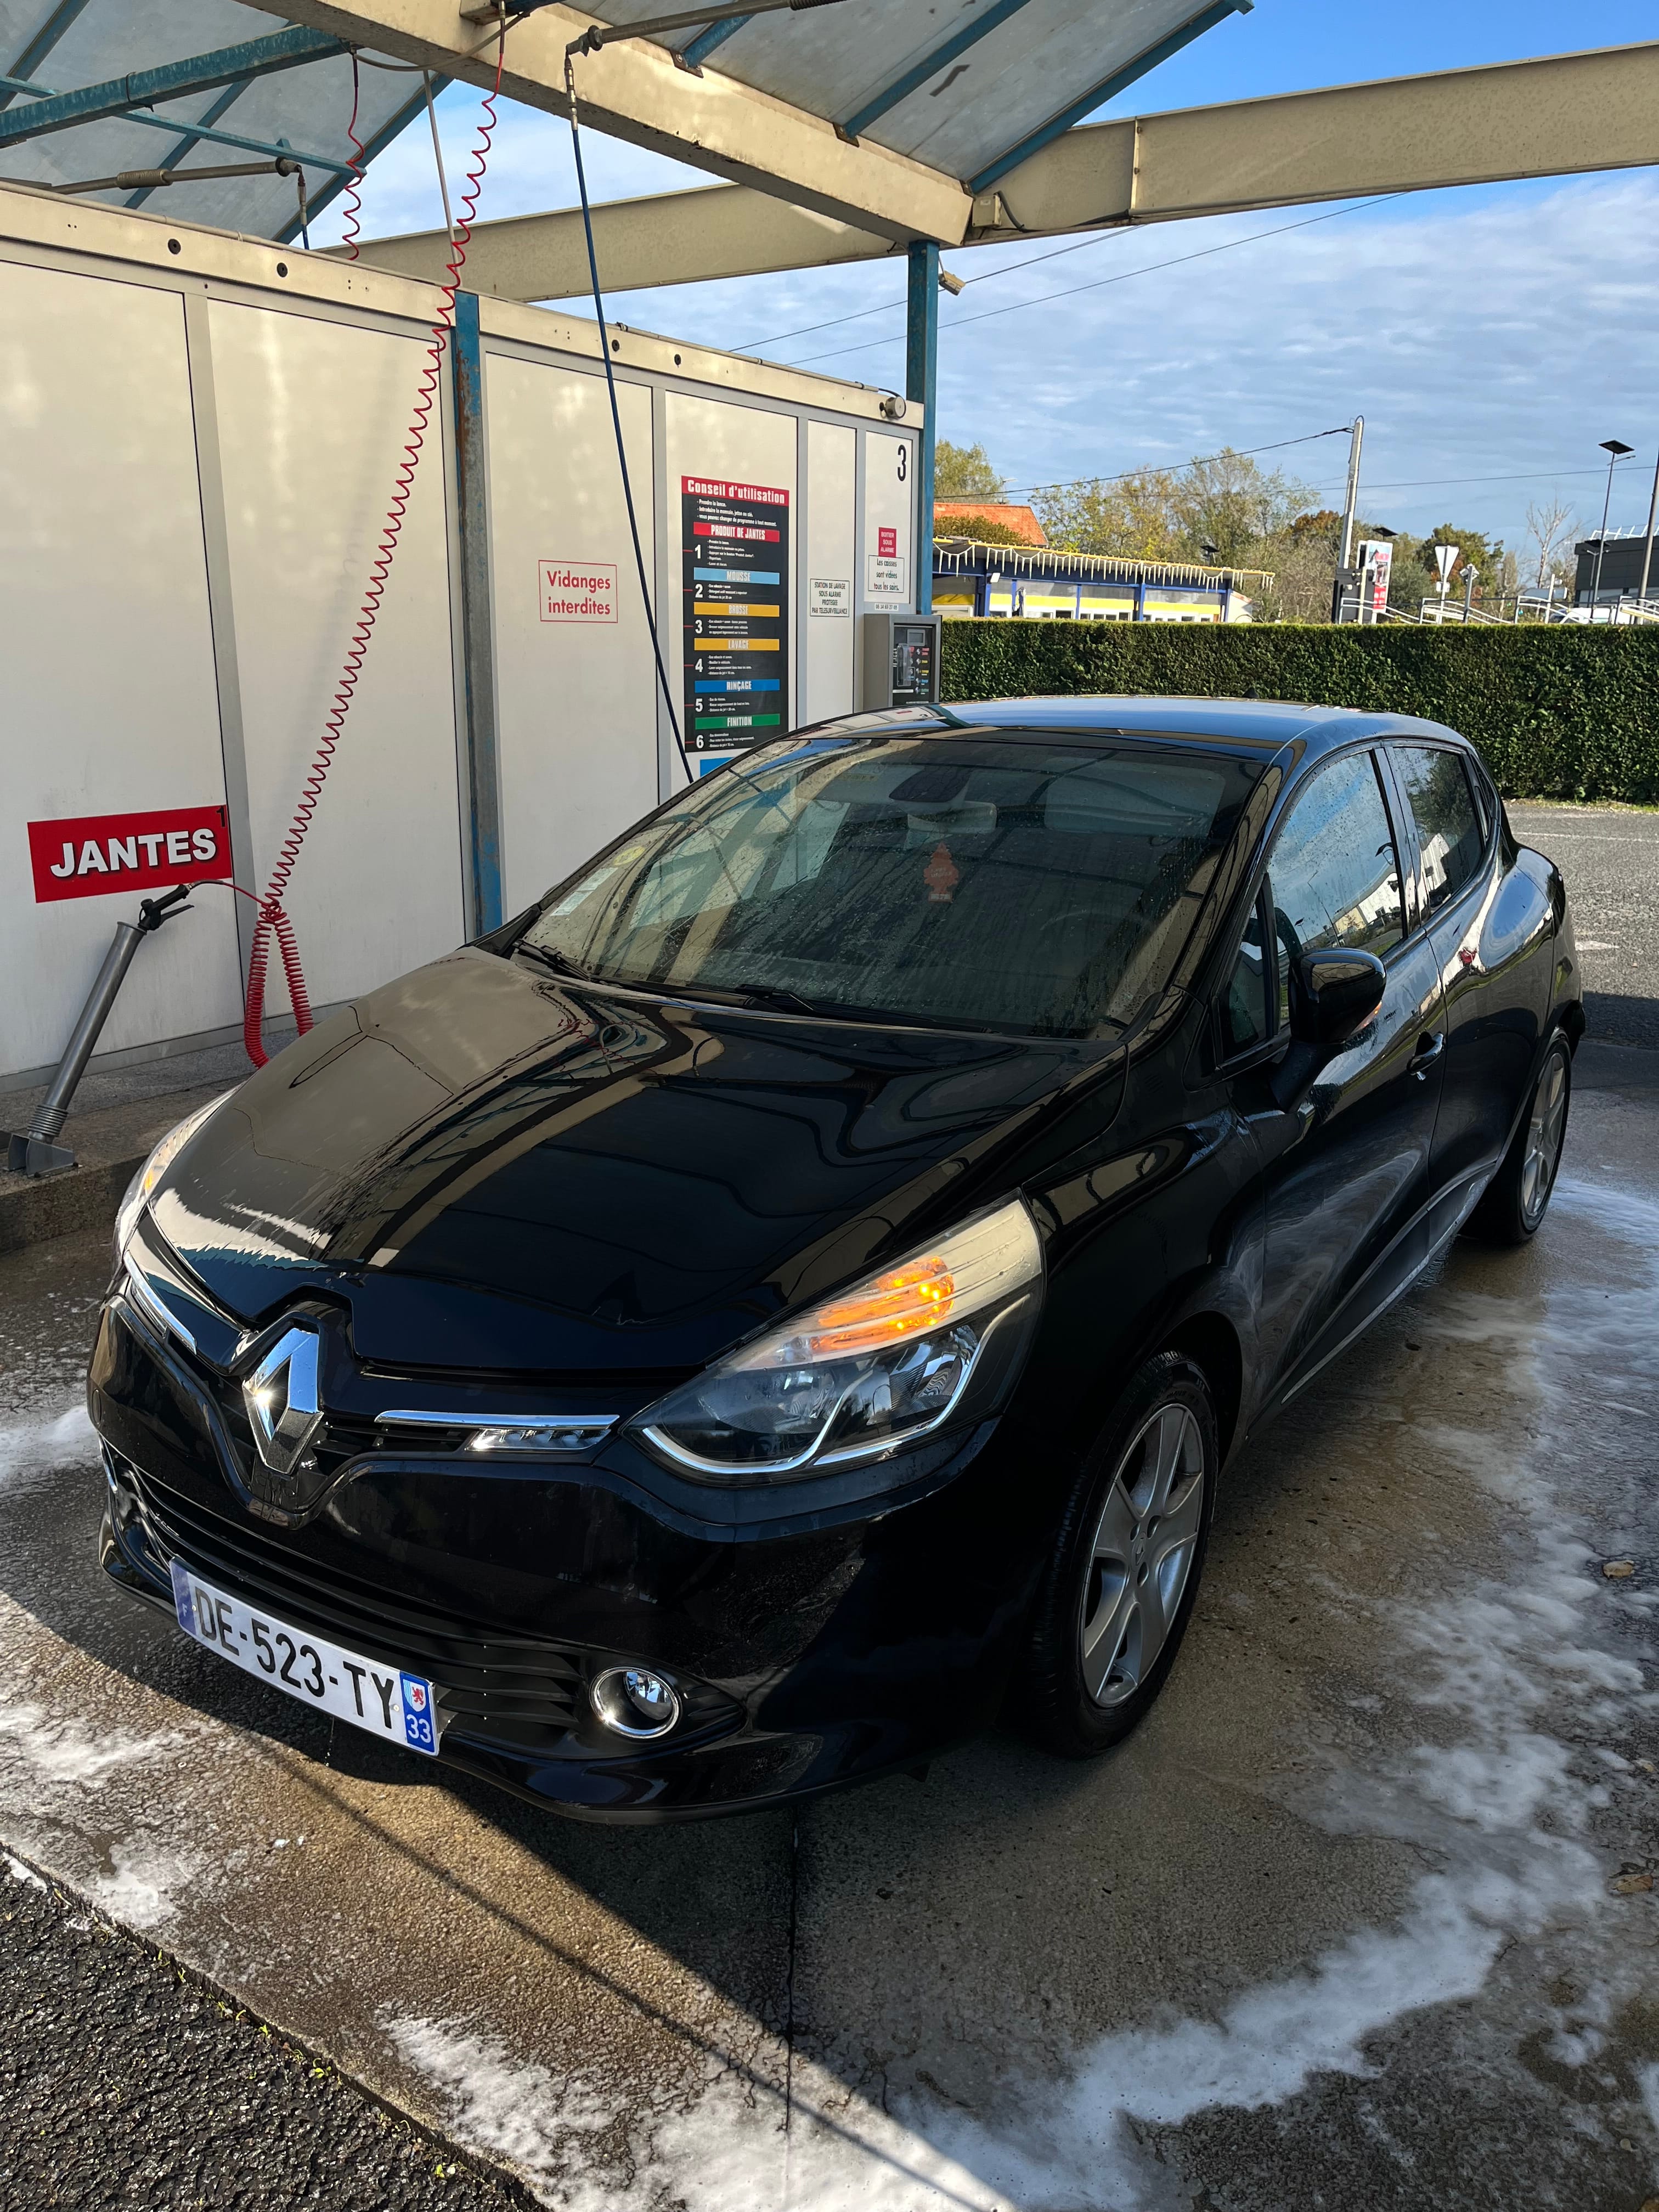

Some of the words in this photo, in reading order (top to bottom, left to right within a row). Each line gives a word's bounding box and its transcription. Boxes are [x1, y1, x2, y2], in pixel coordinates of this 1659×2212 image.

[897, 444, 906, 482] 3
[687, 479, 725, 496] Conseil
[729, 484, 785, 504] d'utilisation
[711, 524, 735, 538] PRODUIT
[737, 527, 744, 538] DE
[745, 527, 765, 540] JANTES
[695, 545, 701, 559] 1
[884, 558, 897, 567] caisses
[547, 570, 611, 594] Vidanges
[727, 571, 751, 582] MOUSSE
[695, 584, 703, 598] 2
[874, 582, 882, 590] tous
[549, 596, 611, 615] interdites
[729, 605, 748, 614] BROSSE
[695, 619, 703, 634] 3
[728, 640, 749, 650] LAVAGE
[695, 658, 703, 673] 4
[726, 681, 752, 691] RINÇAGE
[695, 698, 703, 712] 5
[727, 716, 752, 727] FINITION
[696, 735, 704, 749] 6
[216, 805, 226, 827] 1
[50, 828, 216, 878] JANTES
[182, 1603, 189, 1617] F
[195, 1585, 394, 1729] DE-523-TY
[406, 1714, 432, 1744] 33
